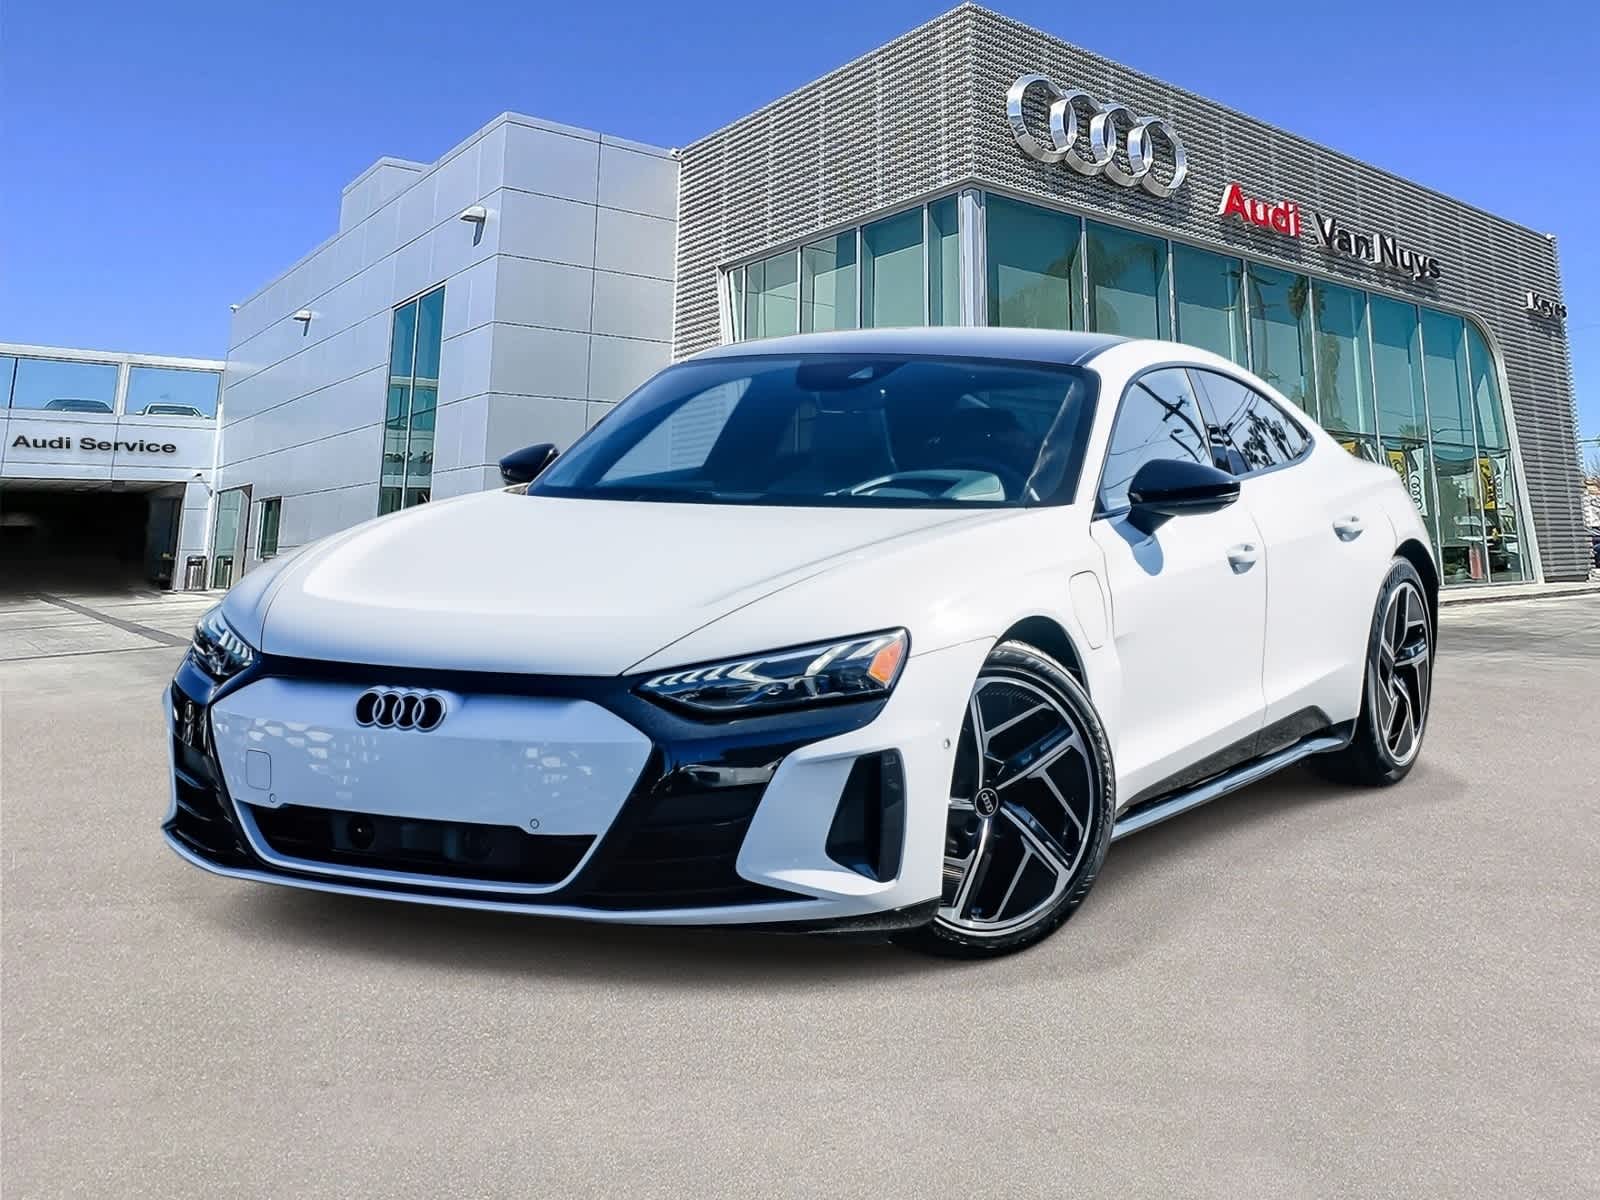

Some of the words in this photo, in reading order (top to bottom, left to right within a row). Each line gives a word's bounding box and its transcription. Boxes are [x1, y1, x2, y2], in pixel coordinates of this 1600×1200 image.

[1219, 182, 1301, 237] Audi
[1311, 212, 1372, 260] Van
[1373, 234, 1441, 280] Nuys
[1527, 292, 1567, 318] Keyes
[12, 434, 71, 449] Audi
[79, 437, 177, 453] Service
